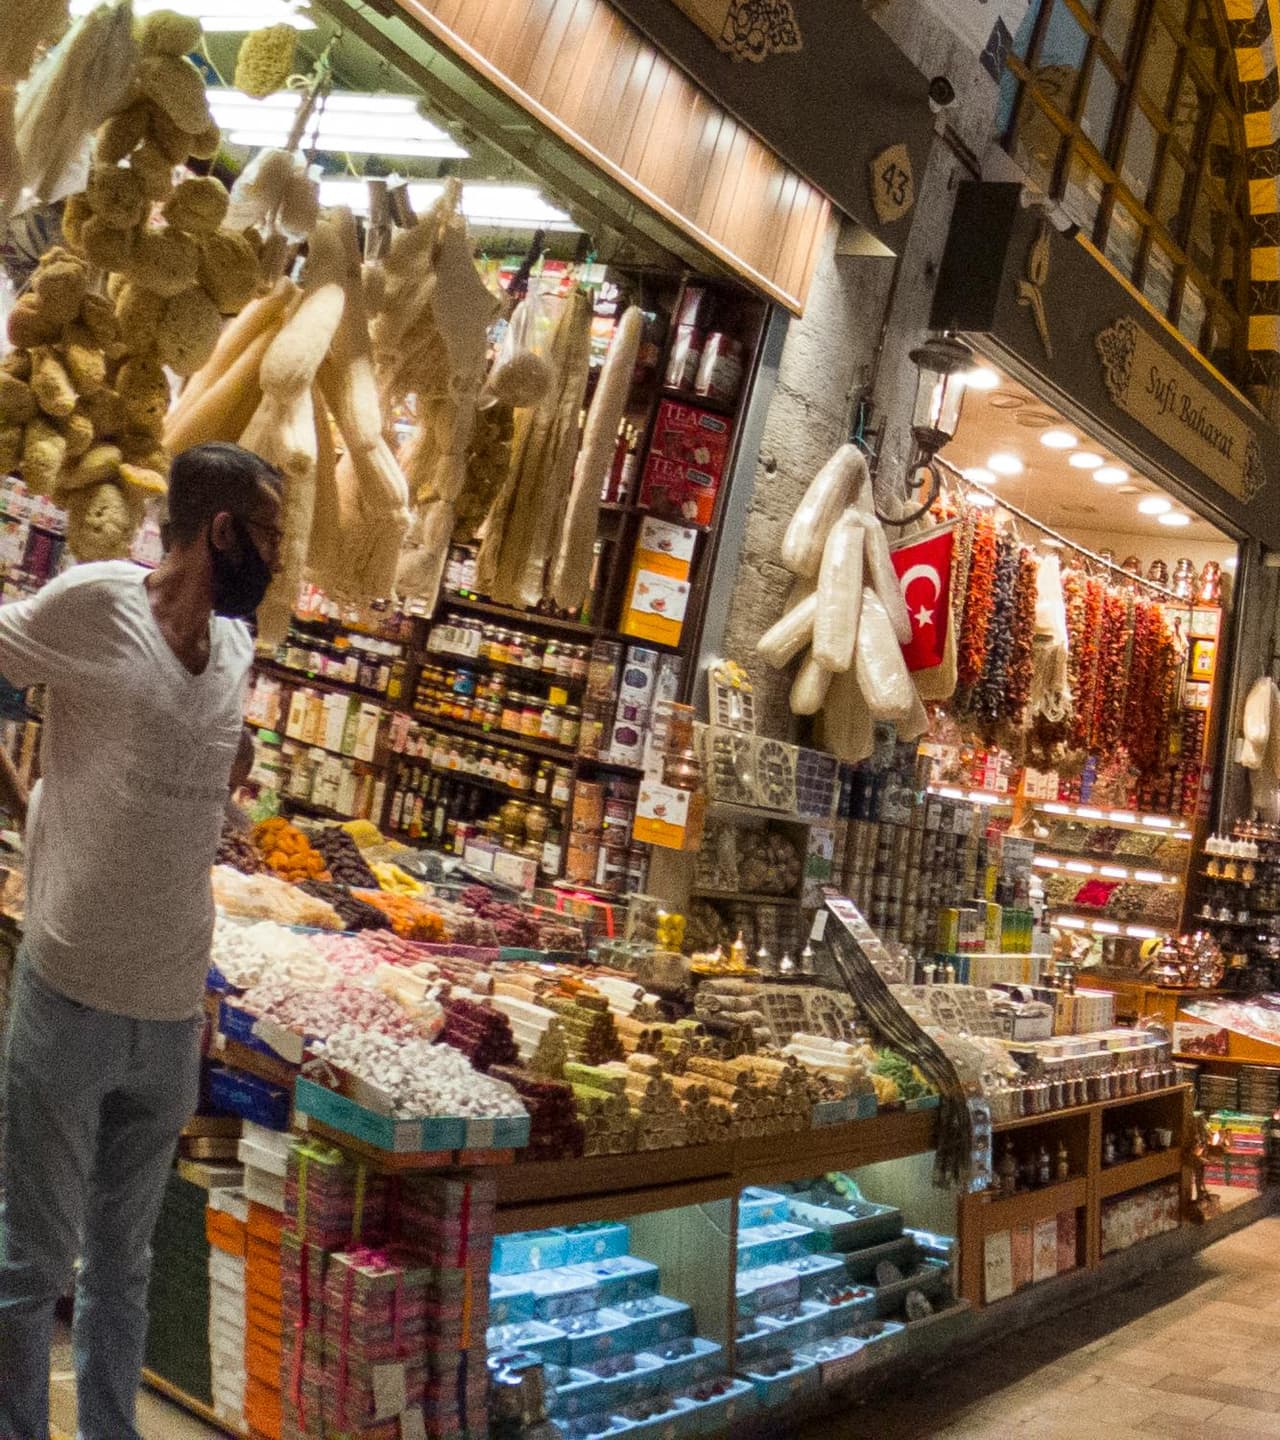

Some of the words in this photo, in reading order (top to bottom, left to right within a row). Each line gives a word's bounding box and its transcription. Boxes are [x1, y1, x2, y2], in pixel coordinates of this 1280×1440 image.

[880, 162, 909, 207] 43
[665, 403, 698, 427] TEA
[1144, 365, 1178, 416] Sufi
[1178, 393, 1235, 461] Baharat
[651, 456, 685, 480] TEA
